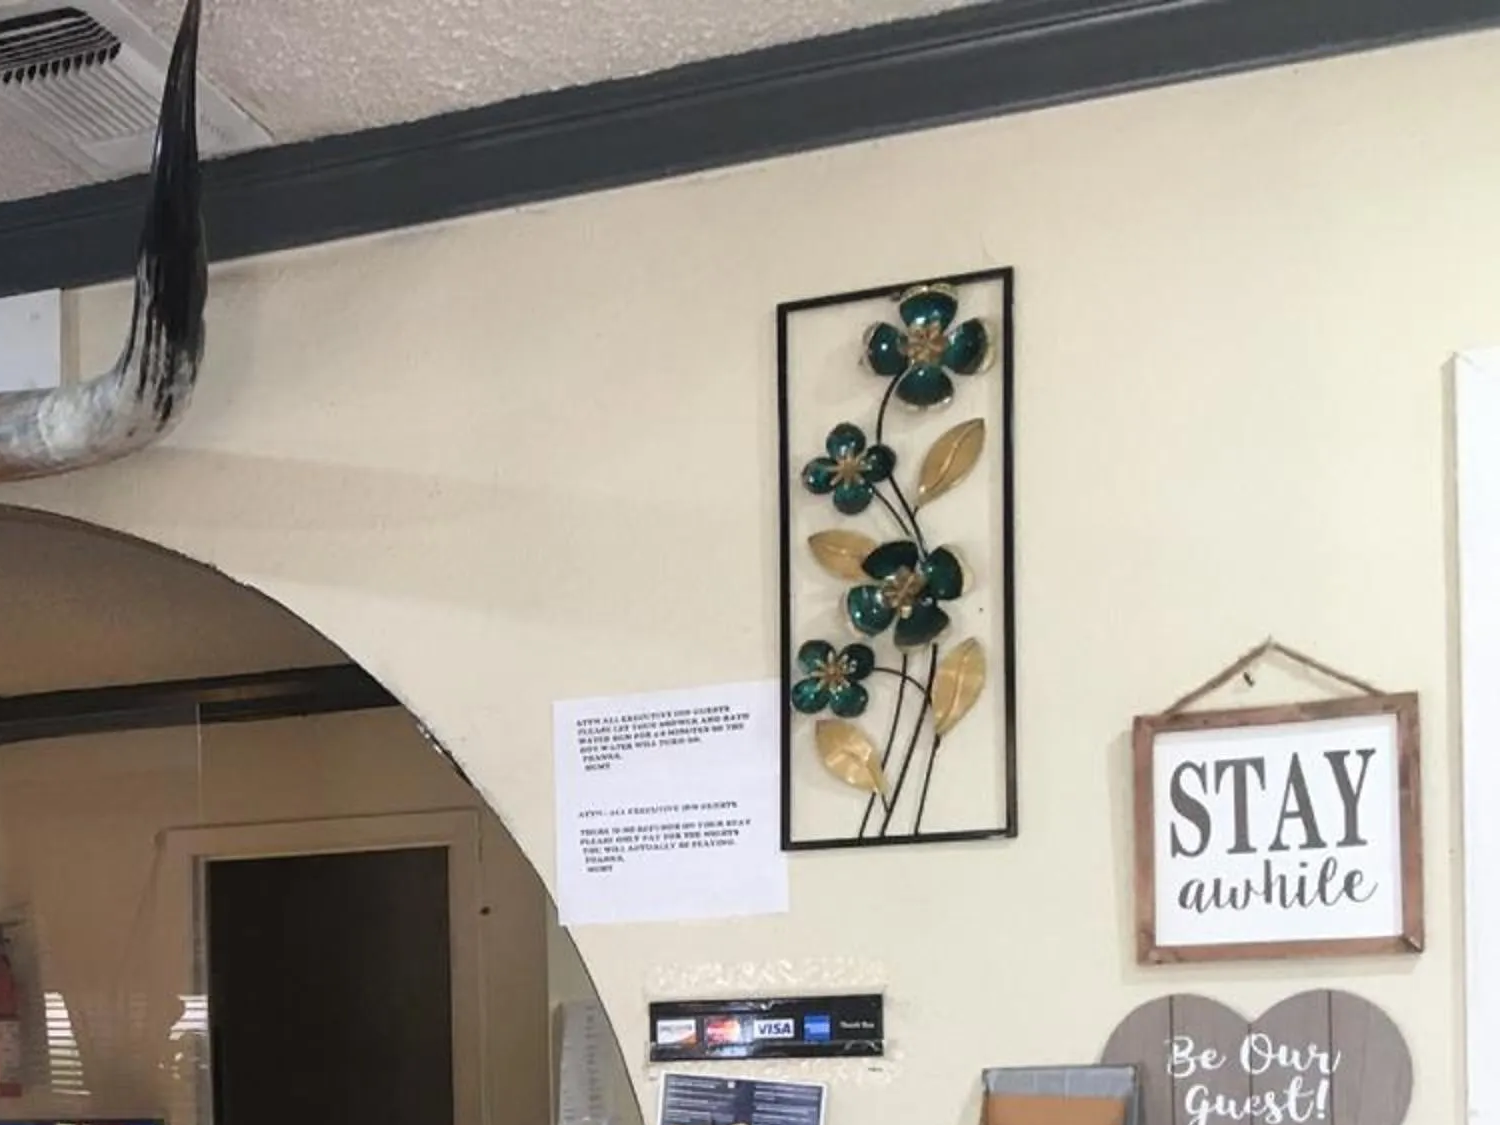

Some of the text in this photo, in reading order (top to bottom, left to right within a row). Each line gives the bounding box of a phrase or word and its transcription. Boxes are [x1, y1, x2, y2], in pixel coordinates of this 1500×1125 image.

[1169, 749, 1376, 859] STAY
[1178, 856, 1378, 913] awhile
[758, 1022, 791, 1036] VISA
[1165, 1033, 1341, 1077] Be Our
